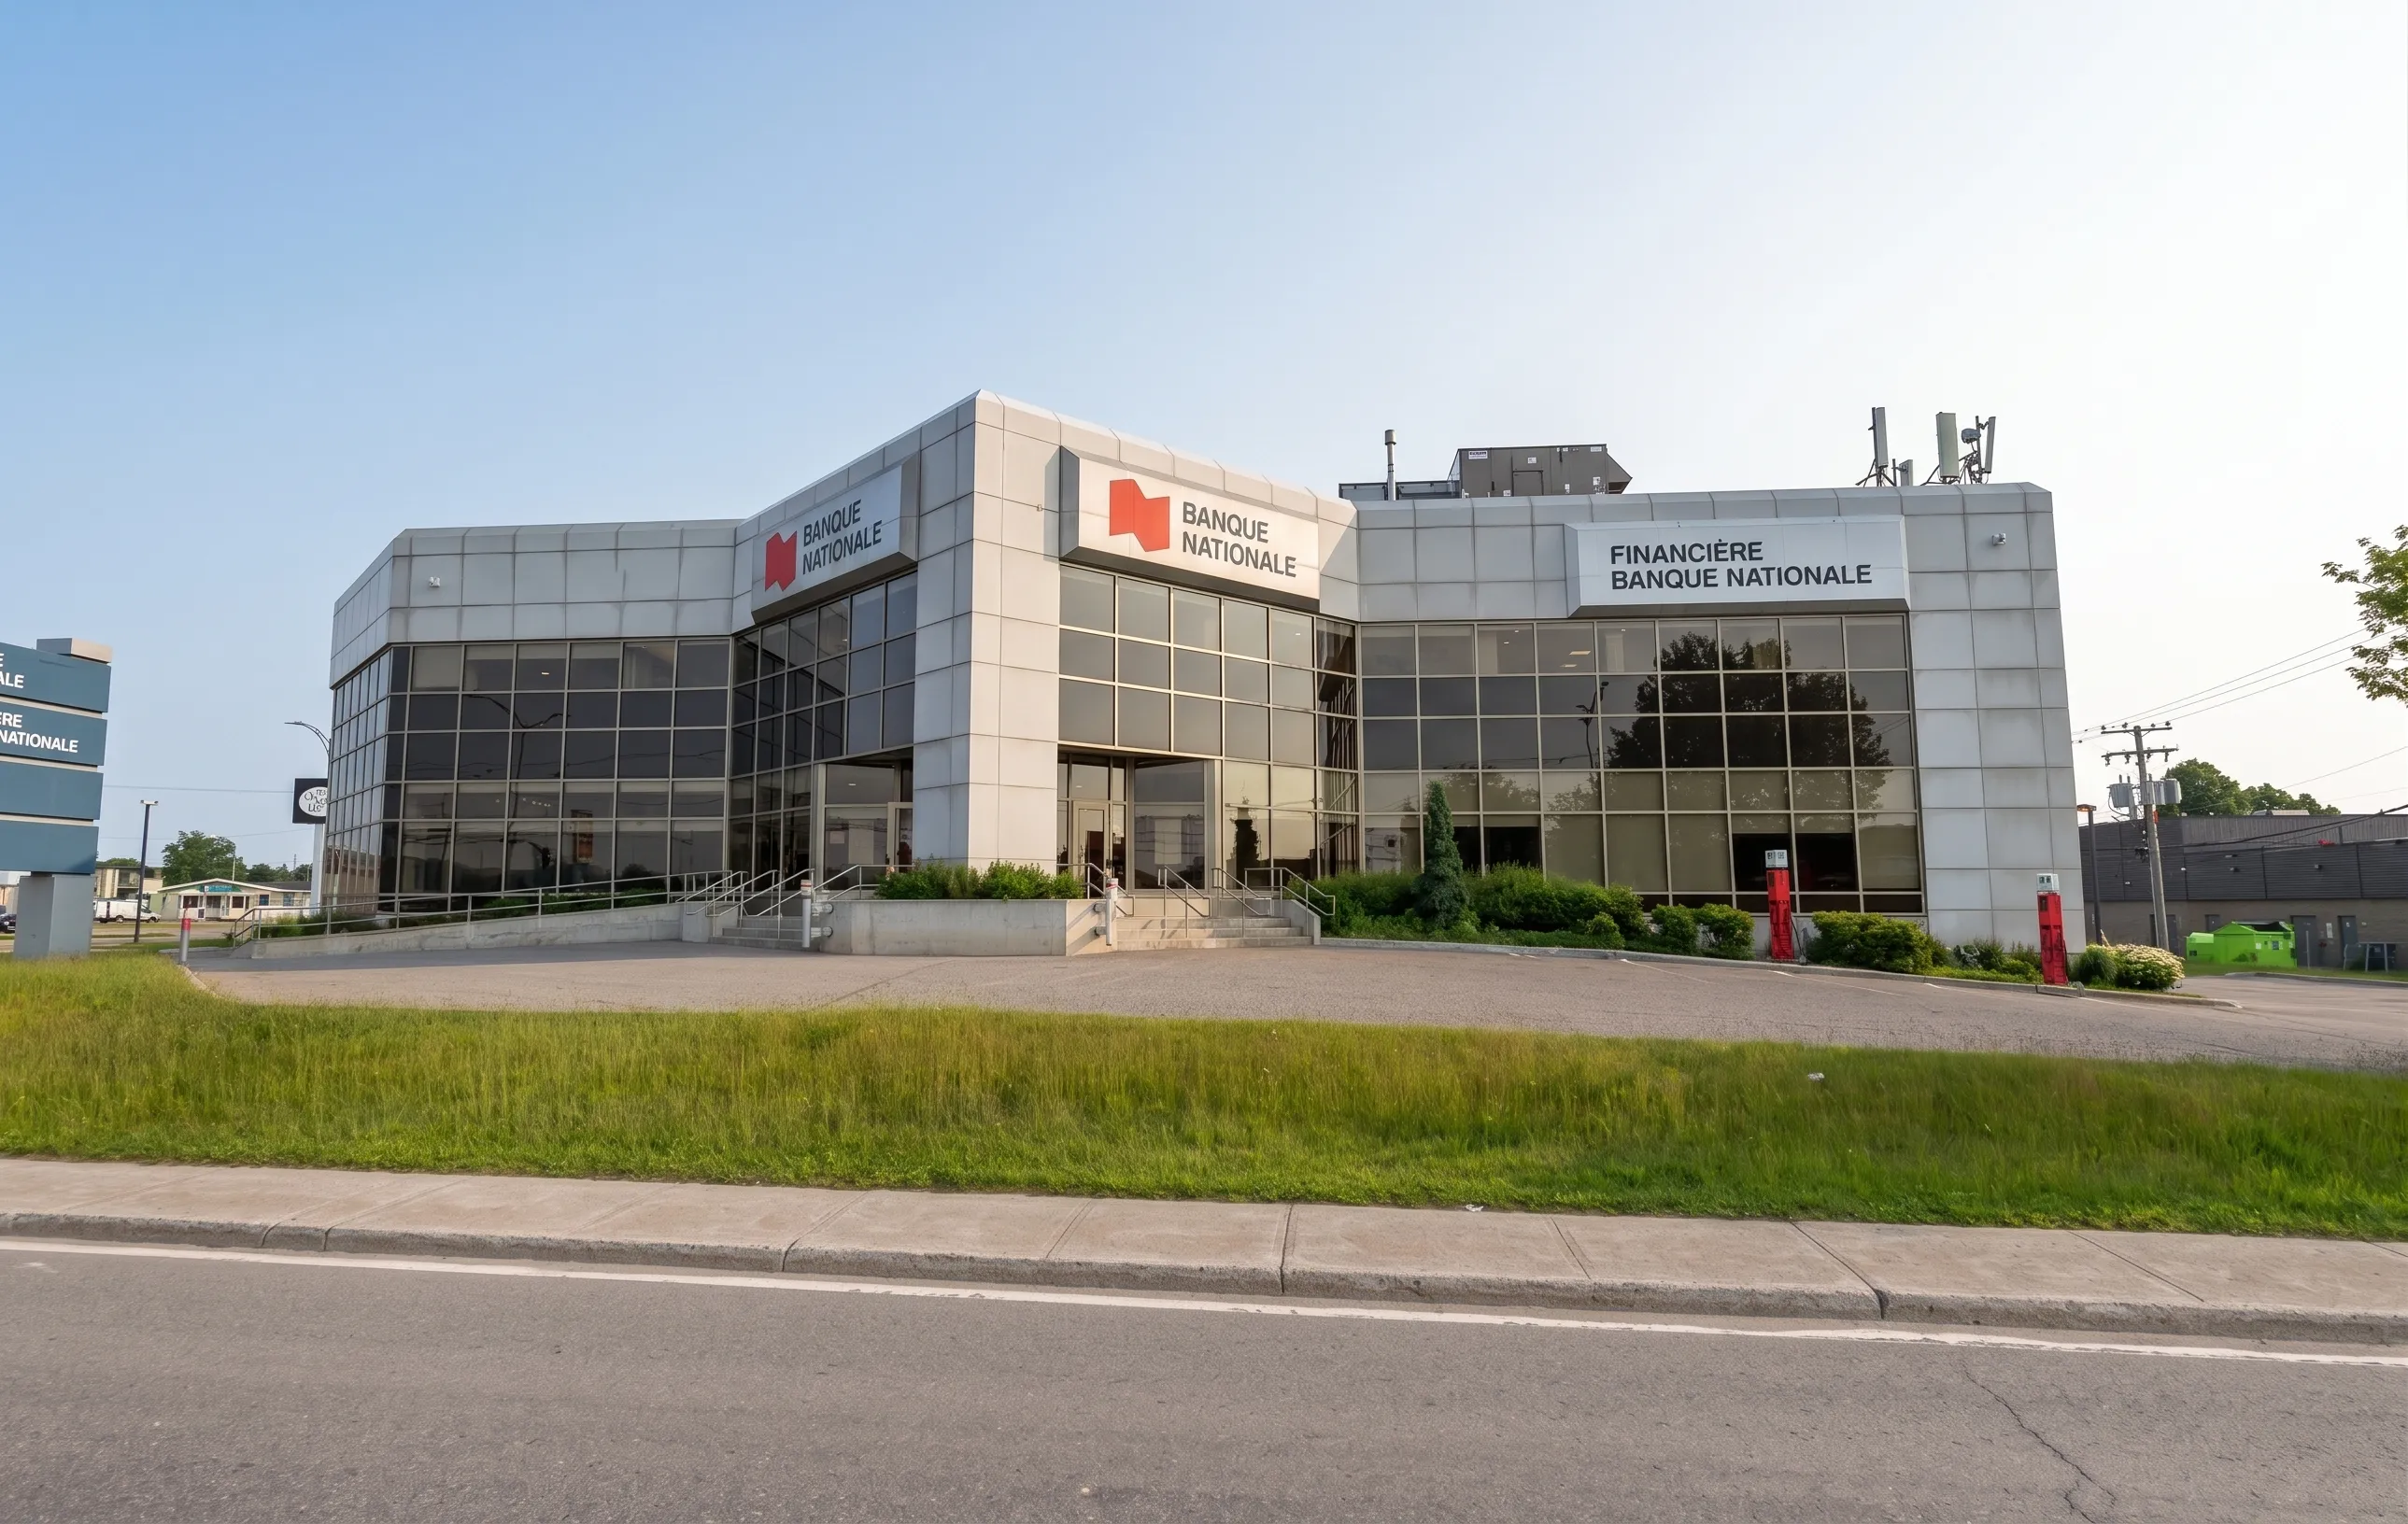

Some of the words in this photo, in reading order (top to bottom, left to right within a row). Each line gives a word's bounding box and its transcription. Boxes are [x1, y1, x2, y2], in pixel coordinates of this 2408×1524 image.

[803, 499, 861, 547] BANQUE
[1183, 501, 1268, 543] BANQUE
[802, 519, 883, 575] NATIONALE
[1183, 531, 1296, 578] NATIONALE
[1610, 539, 1764, 565] FINANCIÈRE
[1611, 568, 1719, 590] BANQUE
[1726, 564, 1873, 588] NATIONALE
[0, 711, 22, 728] RE
[0, 729, 78, 753] NATIONALE
